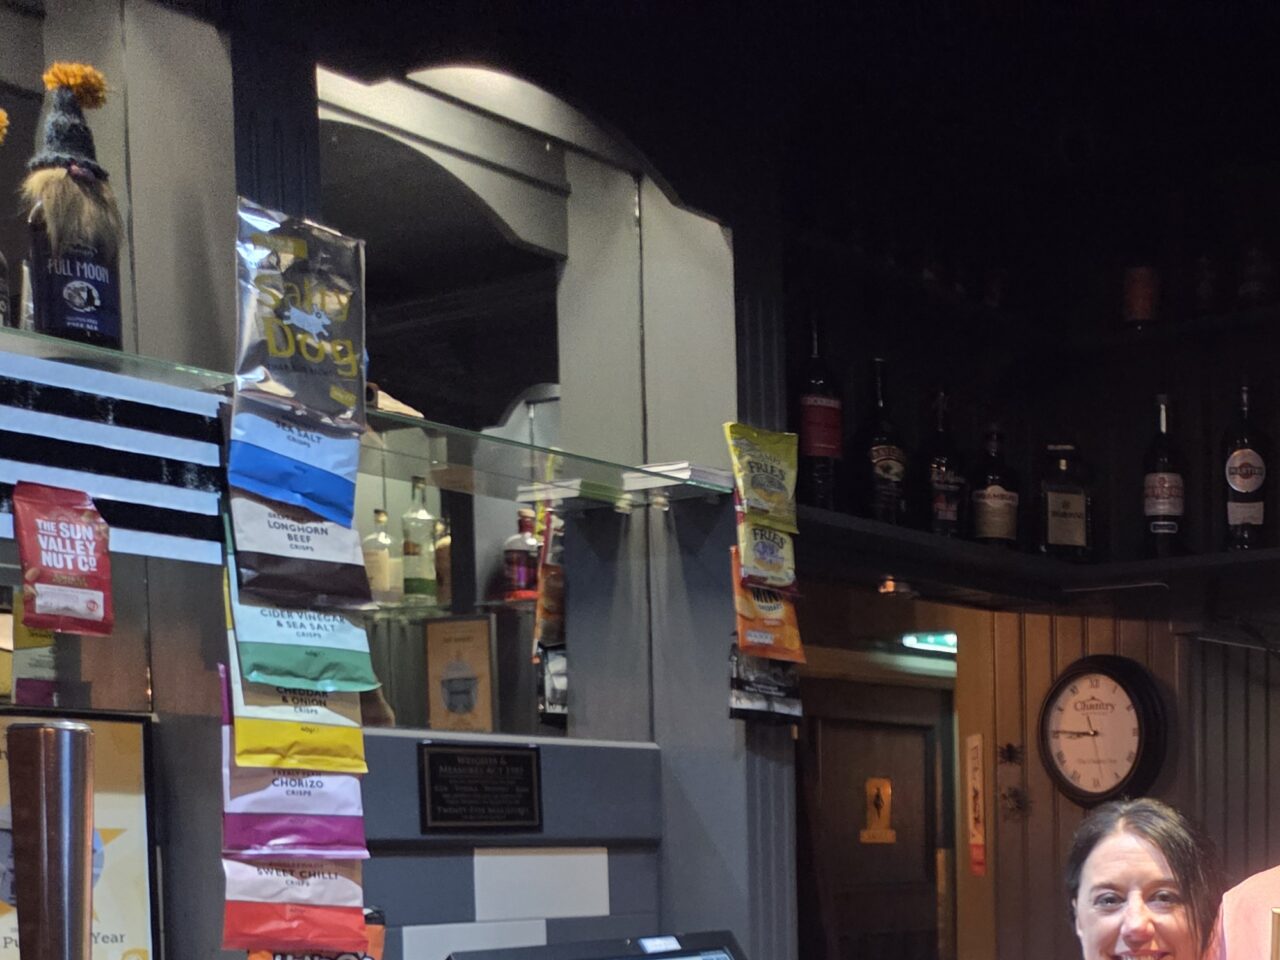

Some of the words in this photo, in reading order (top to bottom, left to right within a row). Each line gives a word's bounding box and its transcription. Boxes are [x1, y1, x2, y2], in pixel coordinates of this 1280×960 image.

[76, 261, 109, 283] MOON
[262, 316, 358, 377] Dog
[299, 428, 322, 443] SALT
[748, 461, 786, 482] FRIES
[35, 518, 57, 533] THE
[59, 521, 94, 541] SUN
[267, 520, 329, 536] LONGHORN
[38, 534, 97, 556] VALLEY
[287, 533, 311, 544] BEEF
[751, 528, 786, 550] FRIES
[41, 552, 76, 570] NUT
[260, 608, 293, 620] CIDER
[296, 609, 345, 625] VINEGAR
[284, 621, 306, 630] SEA
[310, 622, 335, 633] SALT
[290, 696, 327, 707] ONION
[1074, 701, 1116, 713] Chantry
[272, 778, 324, 789] CHORIZO
[257, 867, 296, 877] SWEET
[299, 871, 339, 880] CHILLI
[92, 931, 126, 944] Year
